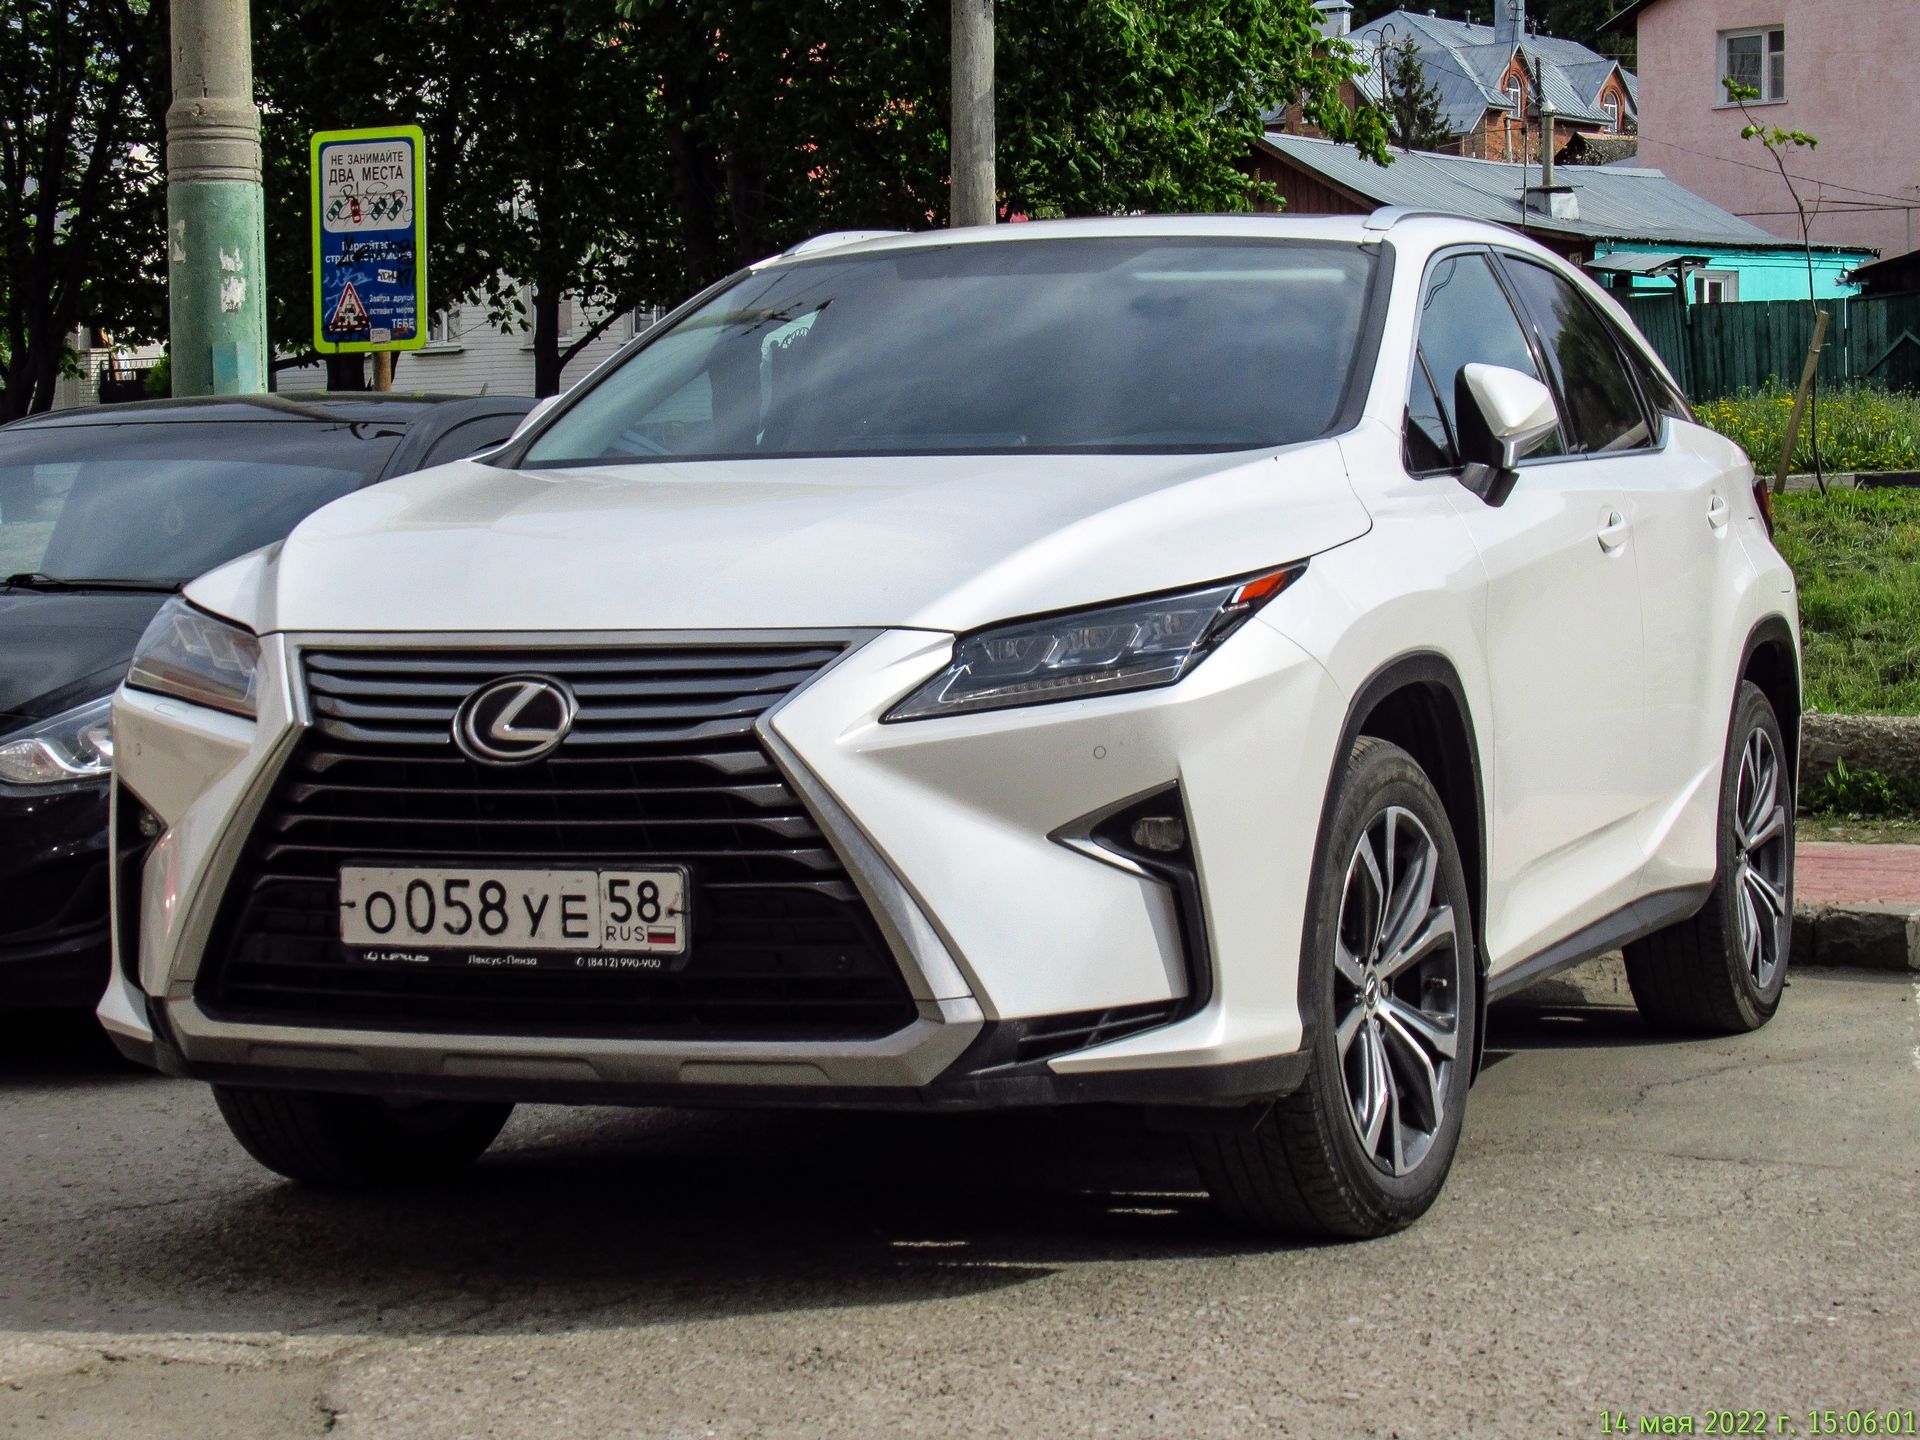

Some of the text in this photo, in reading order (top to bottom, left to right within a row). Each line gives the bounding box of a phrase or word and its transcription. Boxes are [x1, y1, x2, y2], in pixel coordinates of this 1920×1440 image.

[331, 150, 404, 166] НЕ ЗАНИМАЙТЕ
[329, 165, 404, 186] ДВА МЕСТА
[391, 318, 415, 329] ТЕБЕ
[608, 879, 661, 923] 58
[606, 926, 645, 942] RUS
